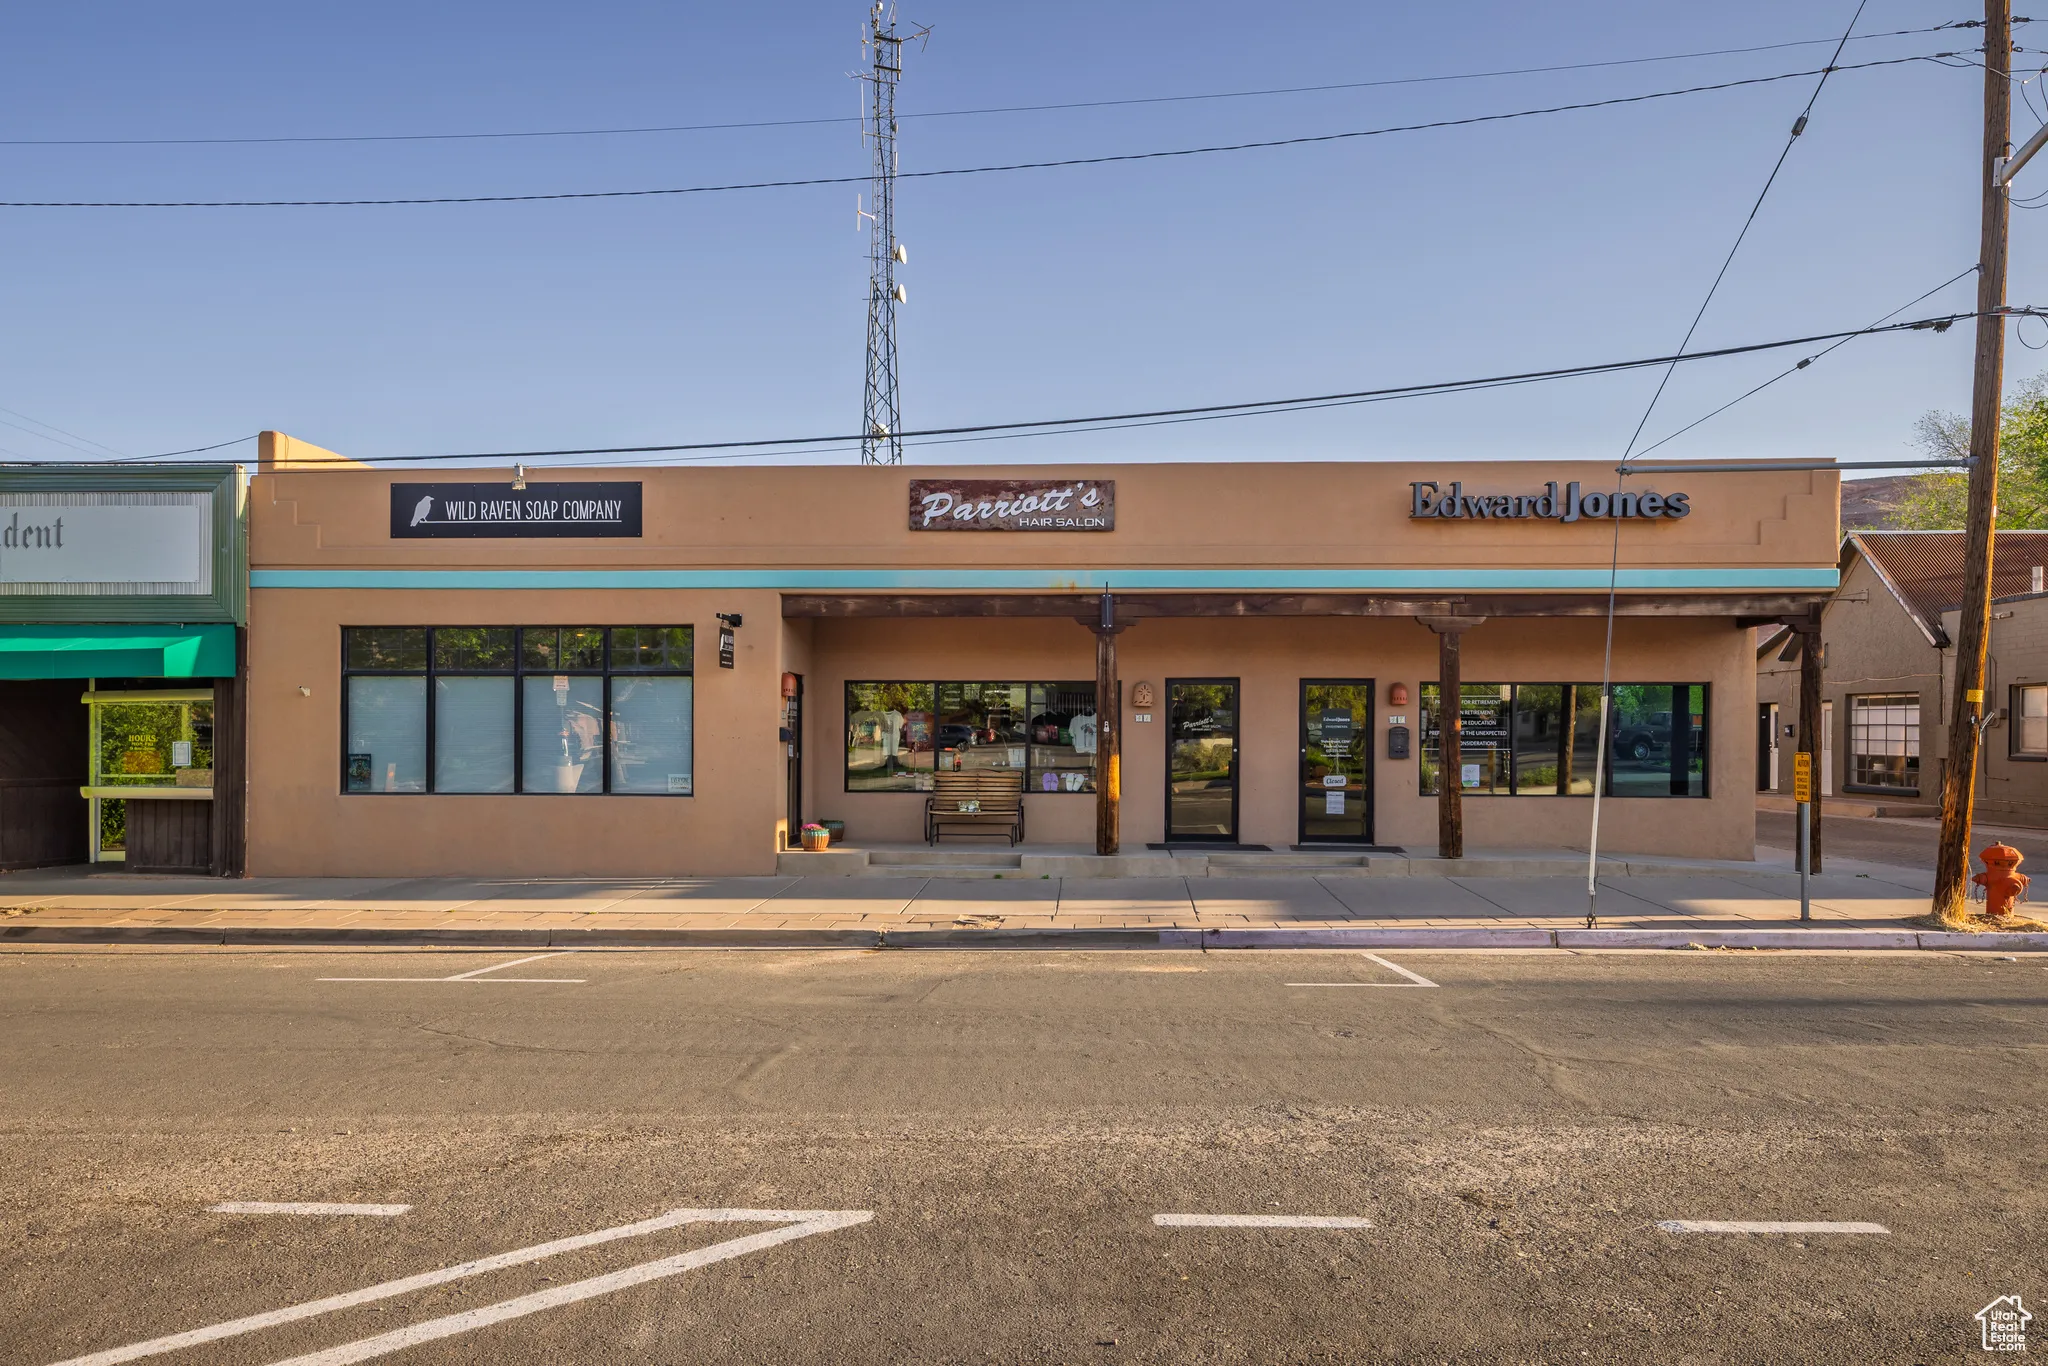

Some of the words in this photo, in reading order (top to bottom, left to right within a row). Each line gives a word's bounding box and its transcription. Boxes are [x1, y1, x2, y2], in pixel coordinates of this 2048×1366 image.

[445, 500, 477, 521] WILD
[480, 500, 521, 520] RAVEN
[525, 500, 558, 520] SOAP
[562, 500, 622, 520] COMPANY
[921, 482, 1101, 527] Parriott's
[0, 511, 65, 550] dent
[1019, 517, 1053, 527] HAIR
[1055, 517, 1105, 527] SALON
[128, 734, 156, 742] HOURS
